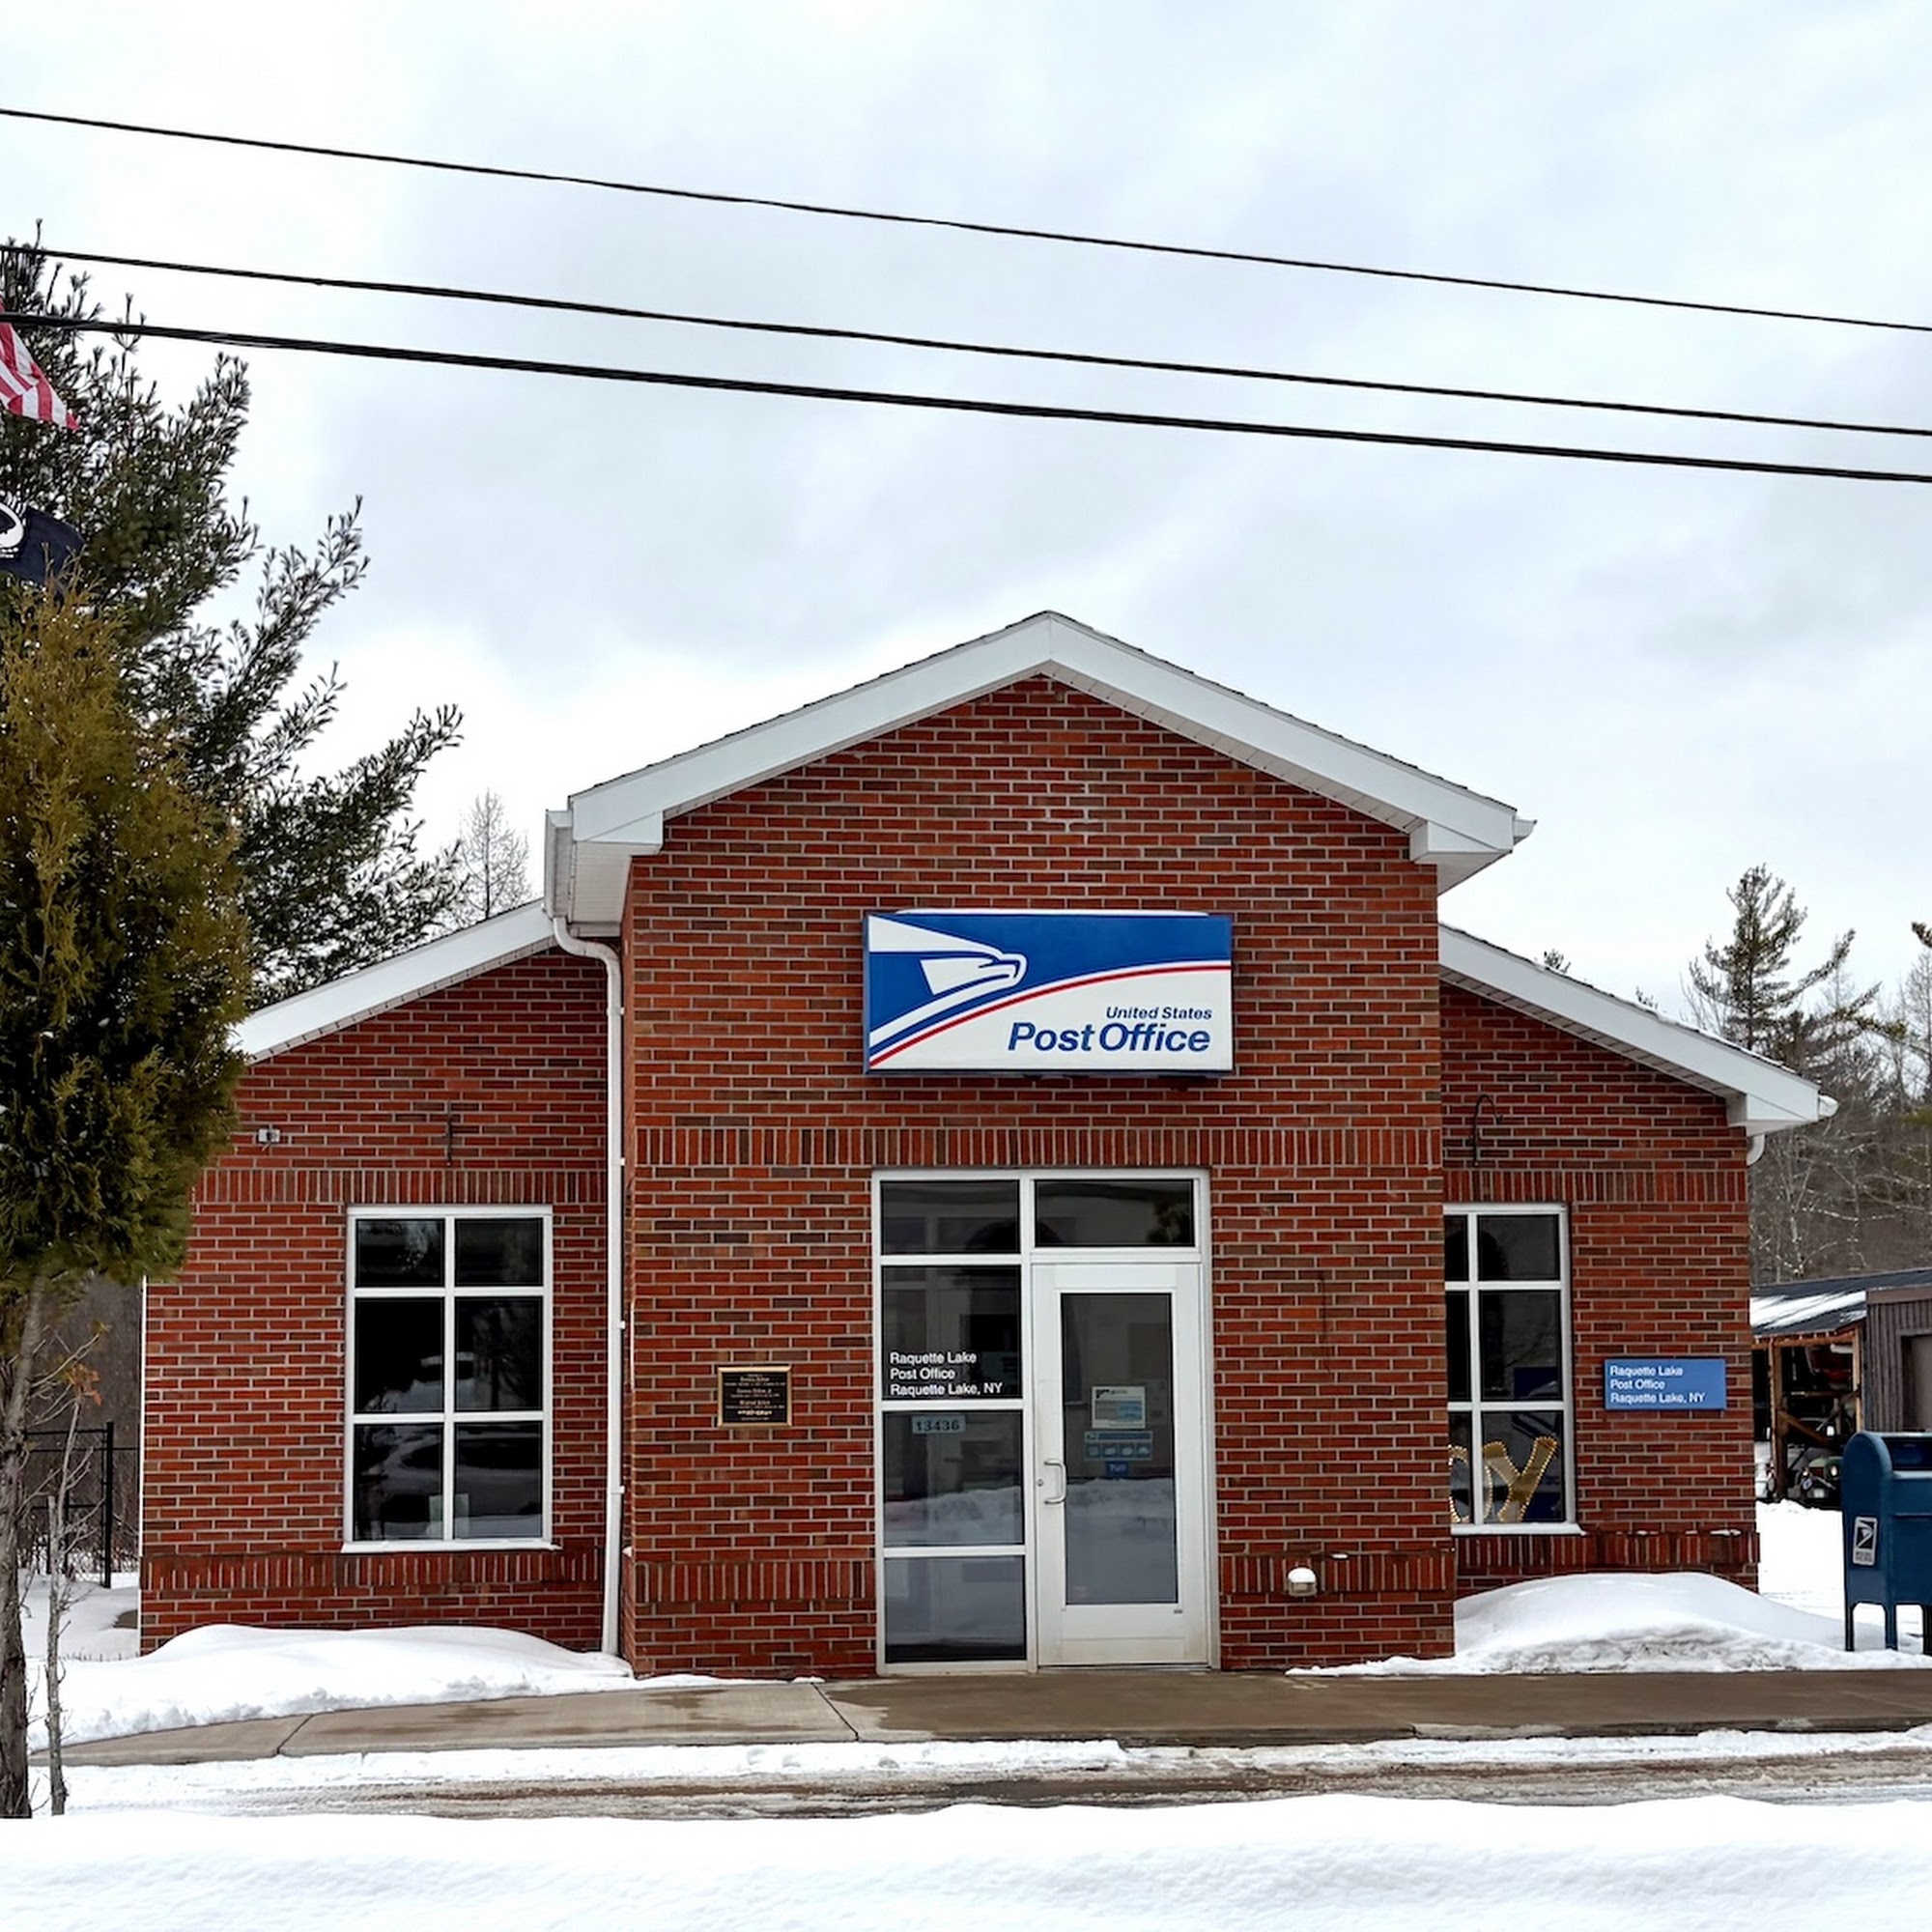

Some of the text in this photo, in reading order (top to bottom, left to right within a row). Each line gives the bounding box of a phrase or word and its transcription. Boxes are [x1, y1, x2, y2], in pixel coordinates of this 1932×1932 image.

[1105, 1007, 1212, 1019] United States
[1008, 1022, 1211, 1052] Post Office
[890, 1351, 977, 1366] Raquette Lake
[890, 1367, 955, 1379] Post Office
[1609, 1365, 1684, 1378] Raquette Lake
[890, 1382, 1003, 1397] Raquette Lake, NY
[1609, 1378, 1665, 1390] Post Office
[1610, 1392, 1705, 1405] Raquette Lake, NY
[917, 1420, 960, 1431] 13436
